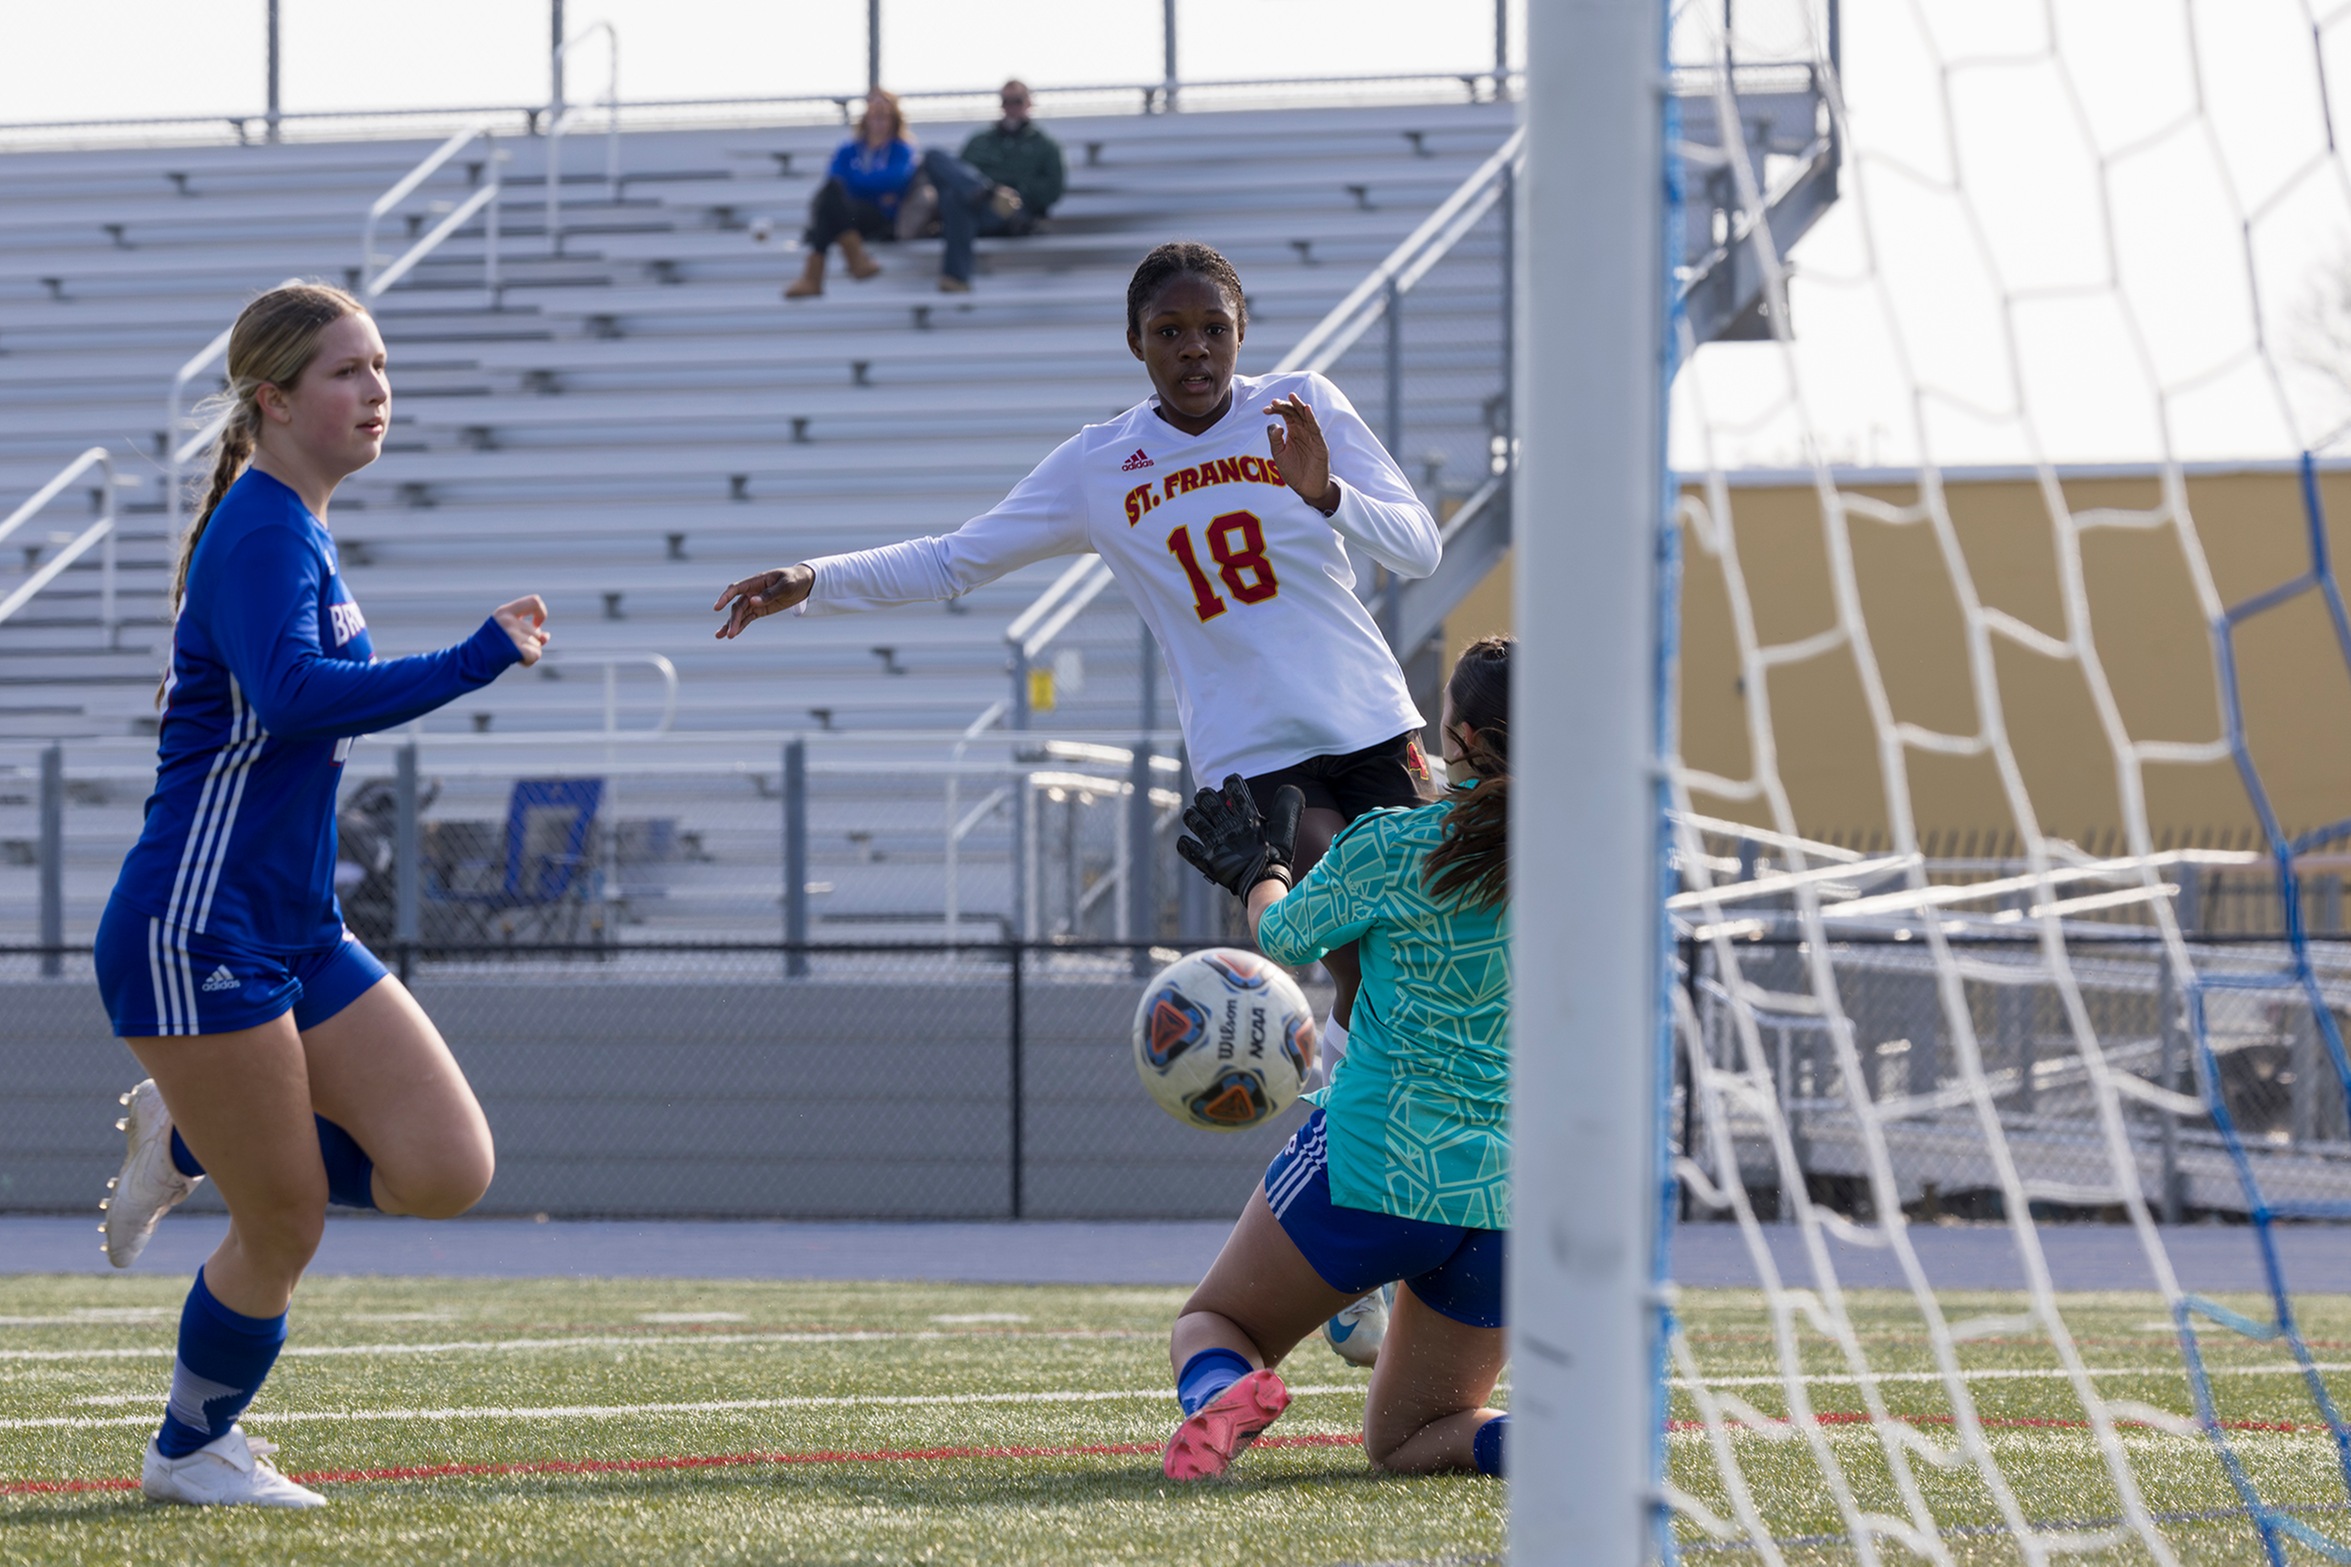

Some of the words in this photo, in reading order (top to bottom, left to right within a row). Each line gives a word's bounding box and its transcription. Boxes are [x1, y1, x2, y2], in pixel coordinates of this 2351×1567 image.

[1121, 459, 1155, 472] adidas
[1124, 482, 1161, 528] ST.
[1163, 455, 1287, 501] FRANCIS
[1166, 509, 1279, 623] 18
[201, 979, 241, 992] adidas
[1217, 999, 1238, 1060] Wilson
[1249, 1007, 1266, 1060] NCAA
